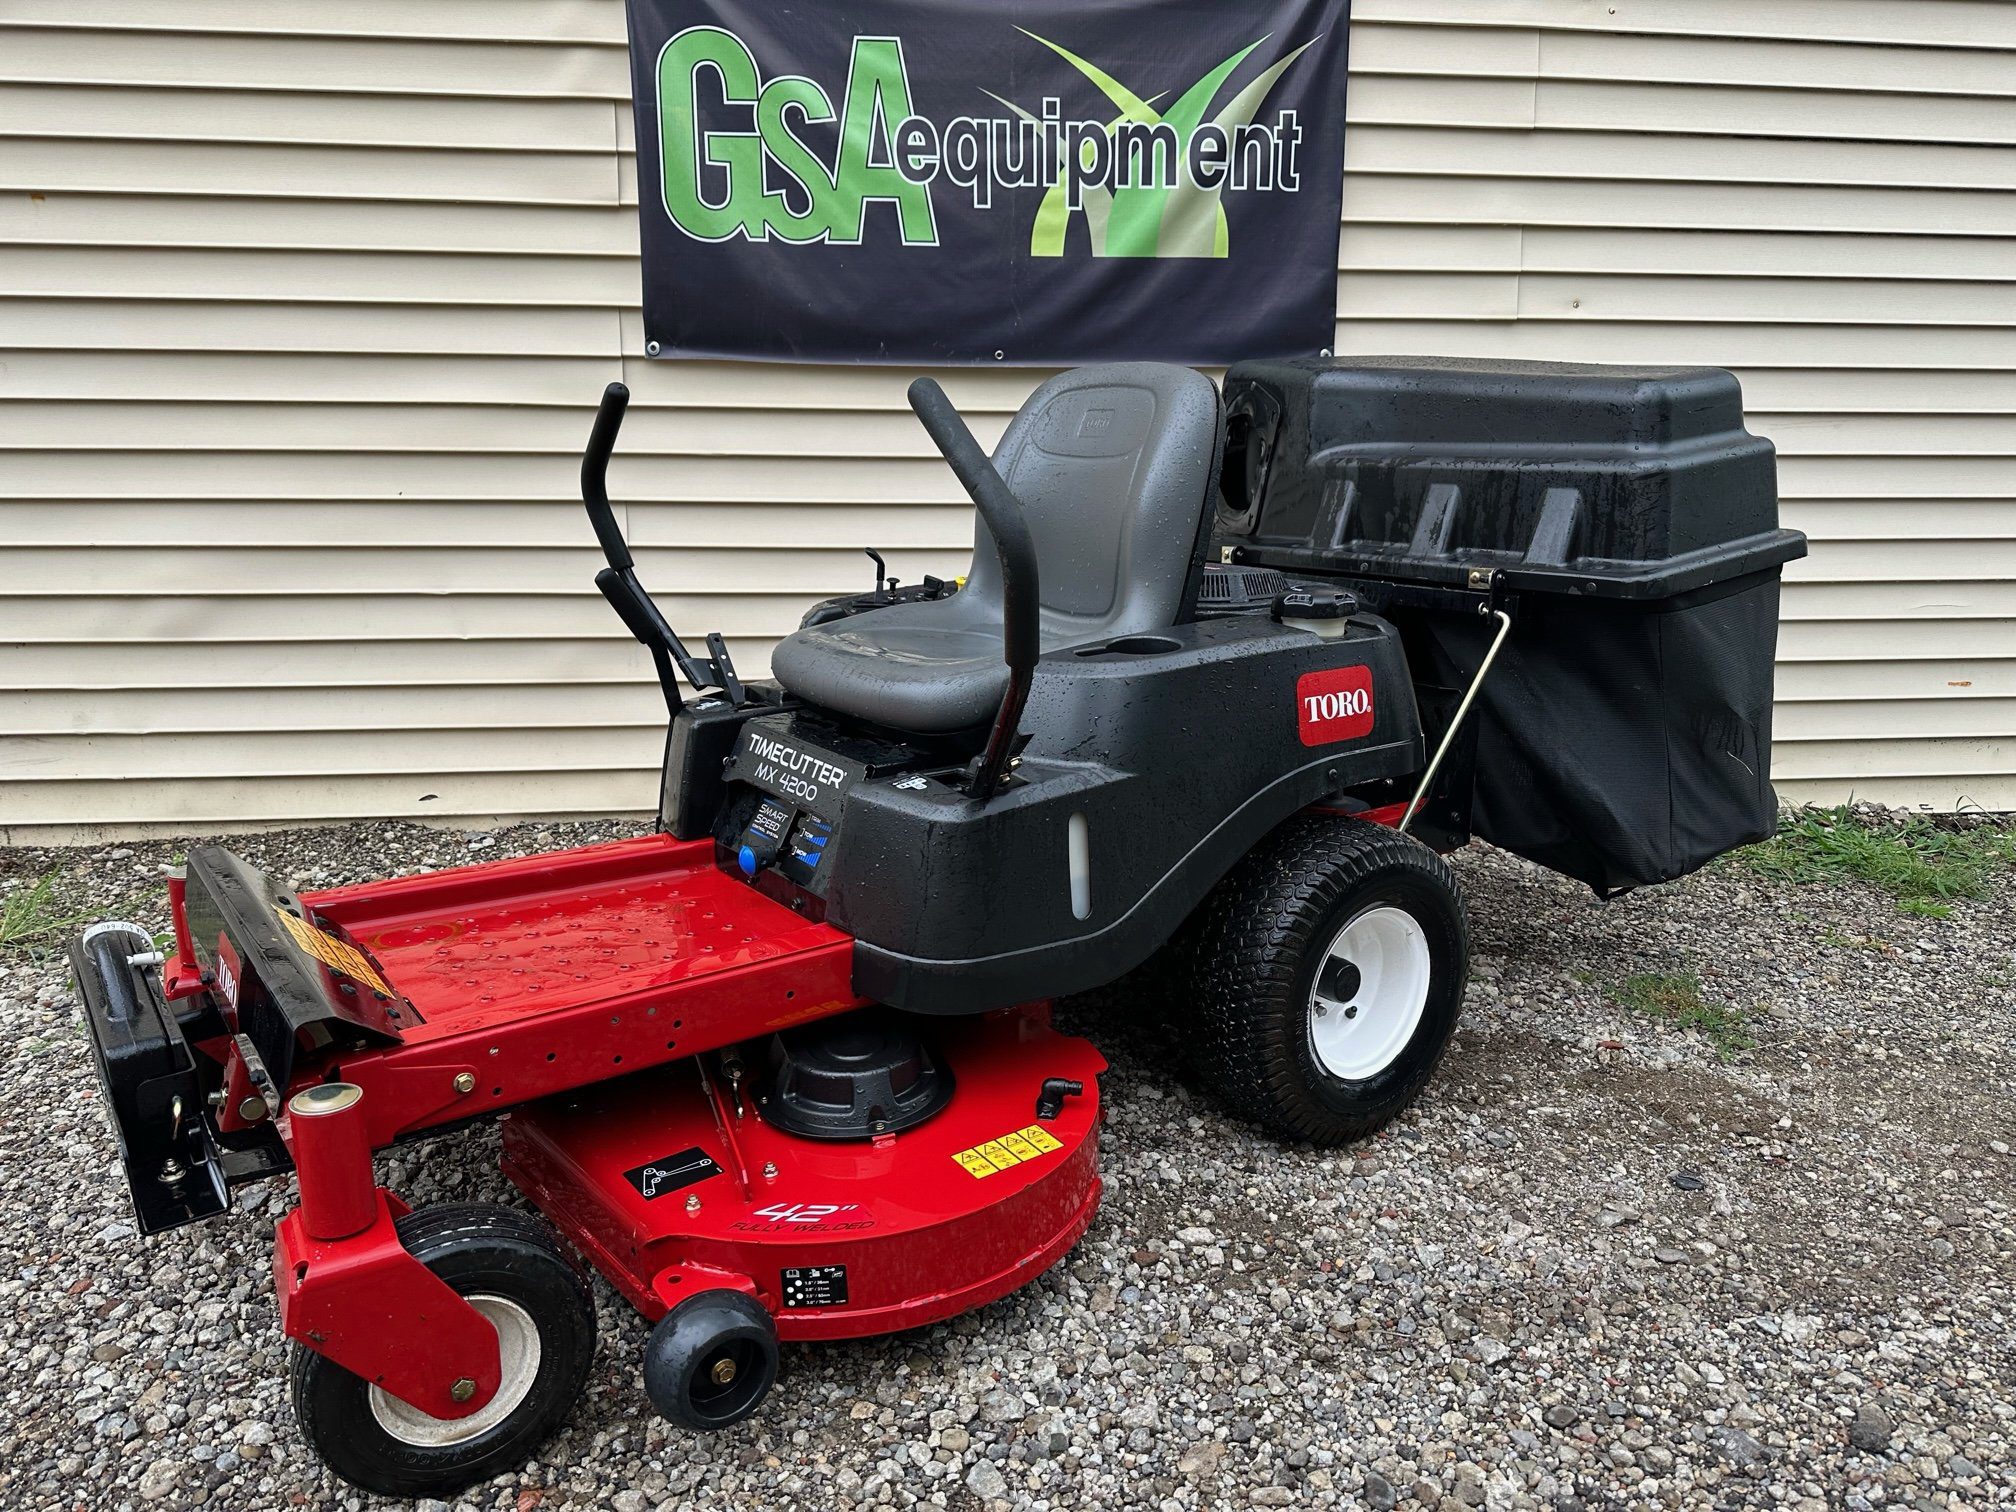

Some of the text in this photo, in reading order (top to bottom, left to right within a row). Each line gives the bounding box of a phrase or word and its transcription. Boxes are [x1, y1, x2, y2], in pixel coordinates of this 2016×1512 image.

[892, 97, 1303, 211] equipment
[1304, 688, 1369, 723] TORO
[748, 733, 844, 789] TIMECUTTER
[754, 762, 818, 802] MX 4200
[754, 813, 781, 832] SPEED
[758, 803, 789, 823] SMART
[728, 1220, 876, 1233] FULLY WELDED
[753, 1203, 860, 1223] 42"
